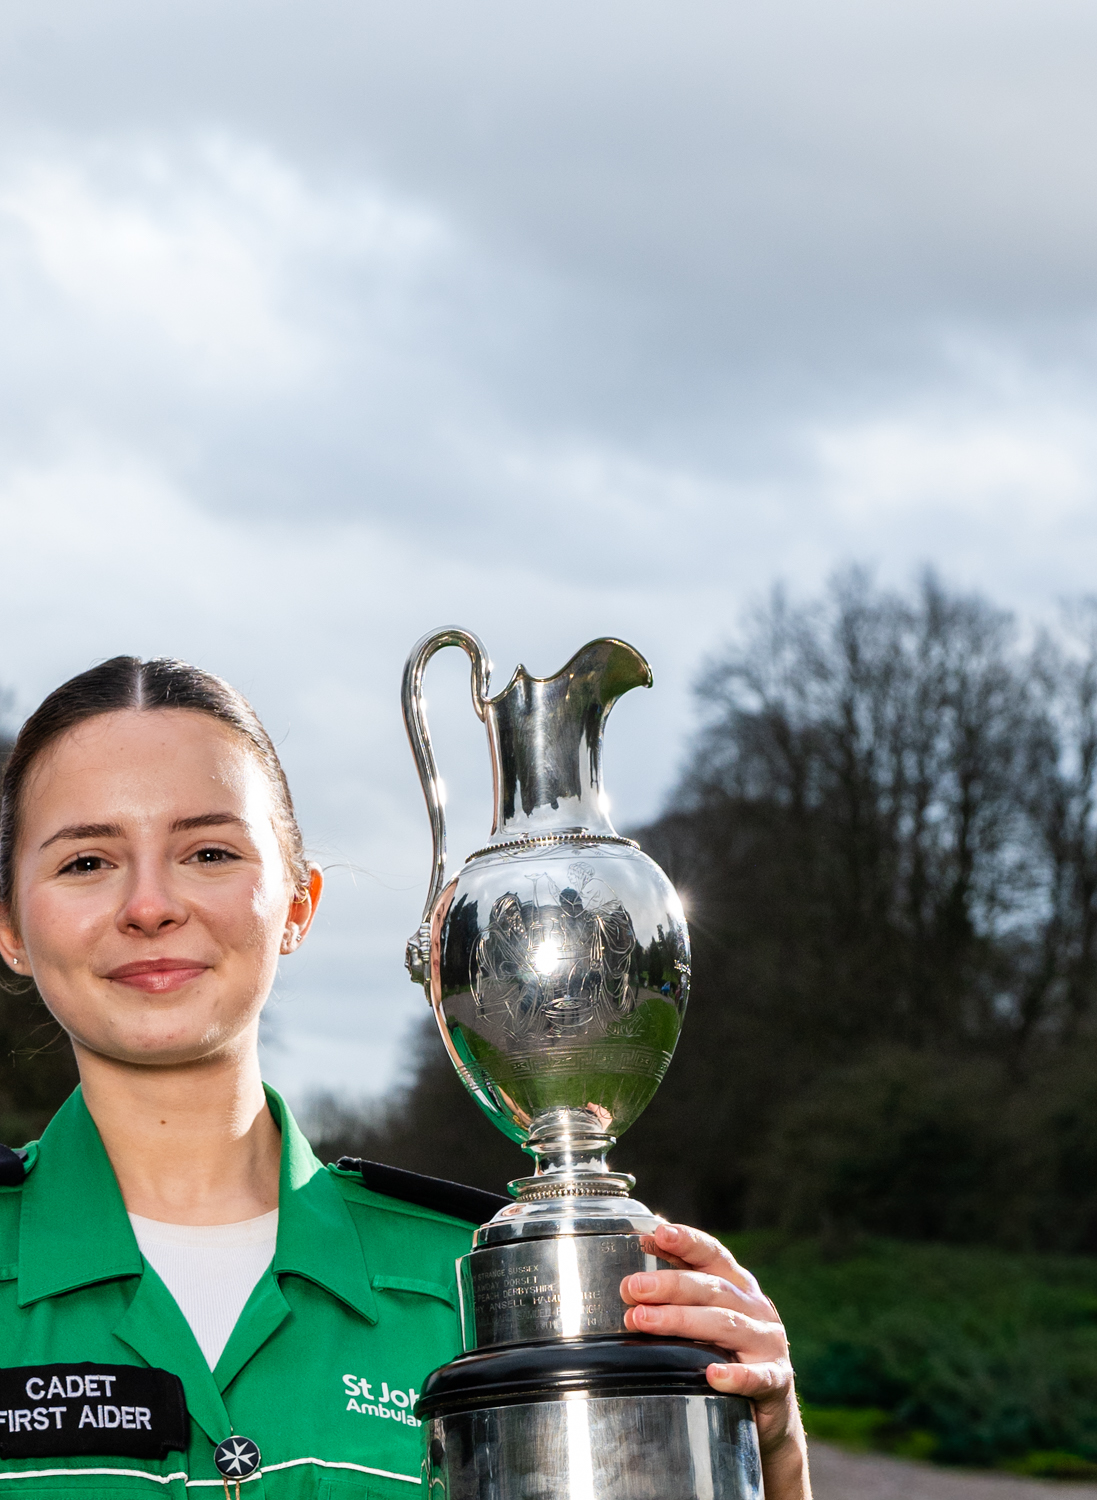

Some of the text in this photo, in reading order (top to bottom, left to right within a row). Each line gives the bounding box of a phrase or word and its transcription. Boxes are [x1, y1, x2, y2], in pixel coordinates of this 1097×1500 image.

[508, 1264, 539, 1275] SUSSEX
[502, 1284, 556, 1299] DERBYSHIRE
[503, 1275, 538, 1288] DORSET
[489, 1298, 526, 1312] ANSELL
[25, 1374, 117, 1401] CADET
[342, 1373, 375, 1401] St
[78, 1404, 152, 1431] AIDER
[345, 1397, 422, 1428] Ambula
